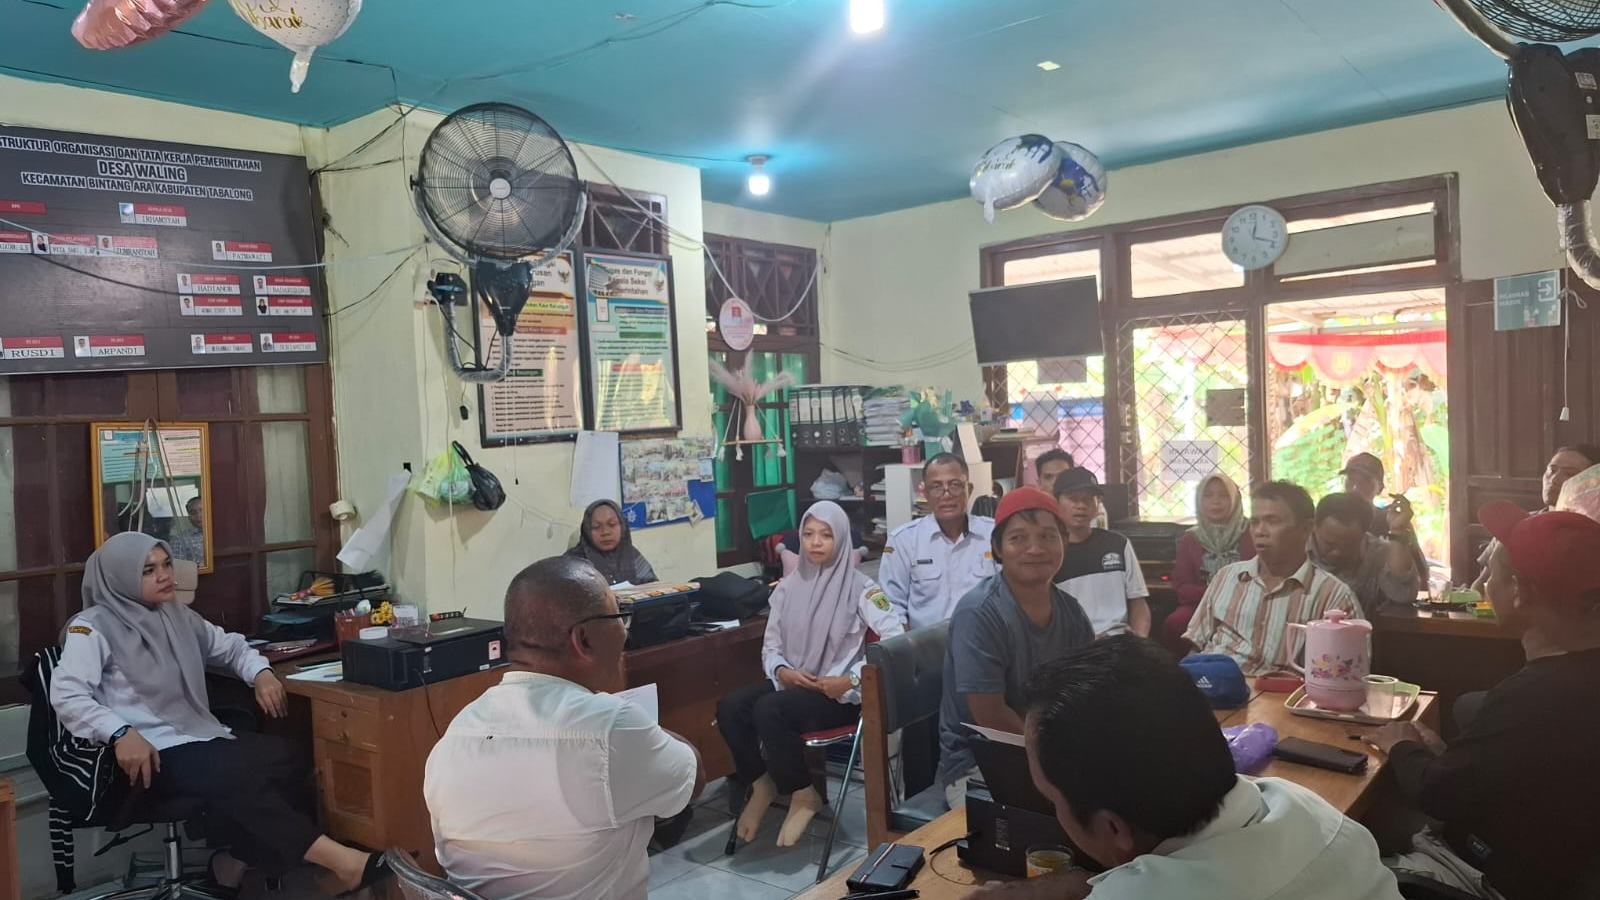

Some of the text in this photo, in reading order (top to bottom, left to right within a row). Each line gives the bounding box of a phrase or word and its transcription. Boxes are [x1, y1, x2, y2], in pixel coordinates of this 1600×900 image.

[53, 140, 116, 158] ORGANISASI
[116, 147, 138, 160] DAN
[139, 149, 162, 163] TATA
[163, 151, 193, 165] KERJA
[194, 155, 261, 172] PEMERINTAHAN
[97, 160, 187, 182] DESA WALING
[21, 171, 253, 201] KECAMATAN BINTANG ARA KABUPATEN TABALONG
[532, 269, 552, 277] rusan
[11, 349, 56, 358] RUSDI
[98, 347, 138, 355] ARPANDI
